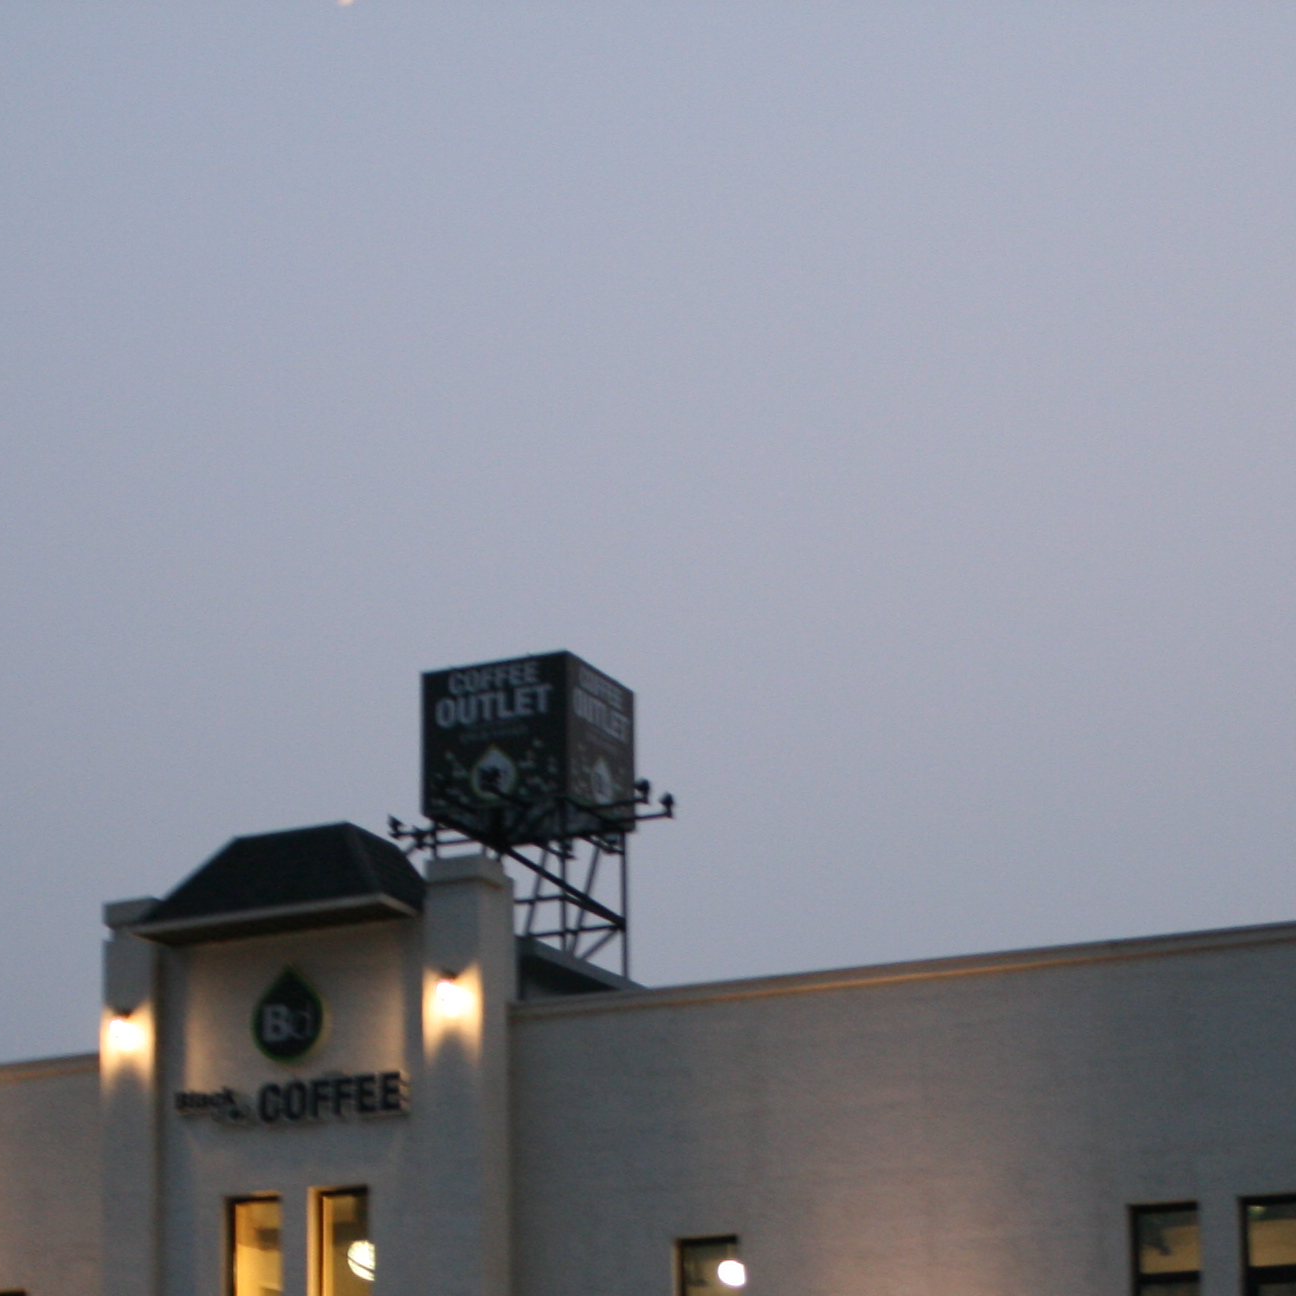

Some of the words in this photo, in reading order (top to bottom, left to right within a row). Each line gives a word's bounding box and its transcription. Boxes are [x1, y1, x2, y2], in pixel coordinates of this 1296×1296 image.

[447, 661, 540, 696] COFFEE
[434, 684, 553, 729] OUTLET
[258, 1071, 401, 1124] COFFEE
